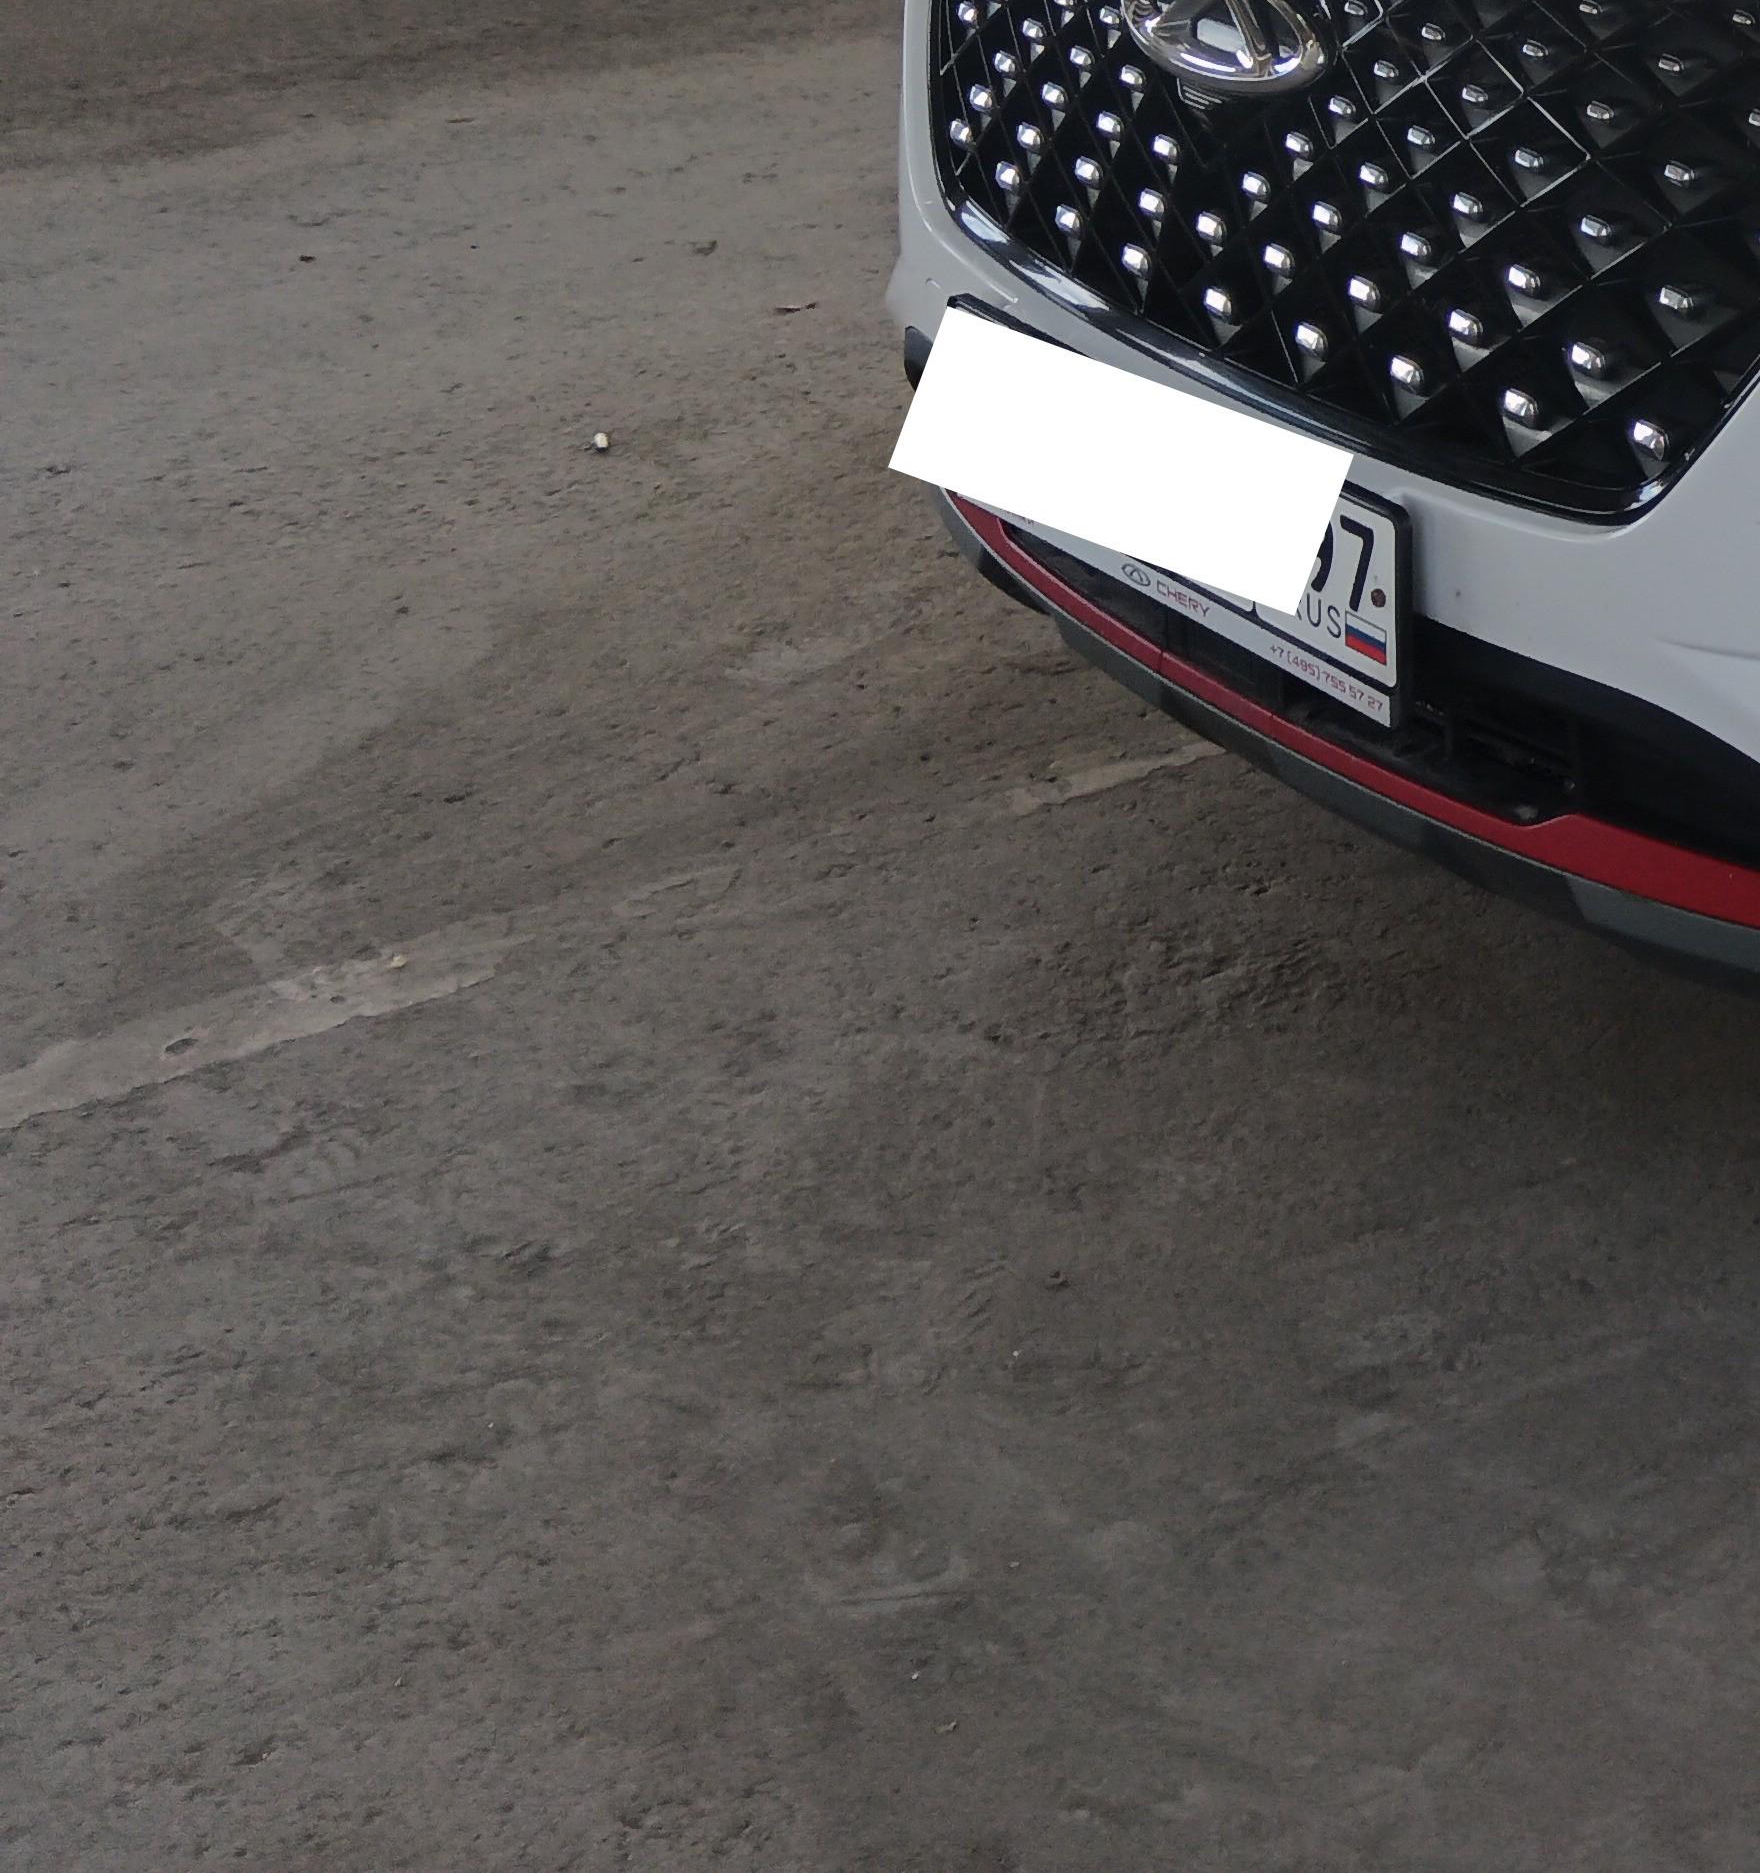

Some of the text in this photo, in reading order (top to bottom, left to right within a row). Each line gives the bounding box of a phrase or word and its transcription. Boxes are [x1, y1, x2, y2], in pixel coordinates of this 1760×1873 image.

[1156, 580, 1210, 616] CHERY
[1297, 593, 1342, 638] US
[1269, 645, 1284, 658] +7
[1321, 672, 1346, 693] 755
[1349, 685, 1364, 701] 57
[1367, 695, 1383, 711] 27
